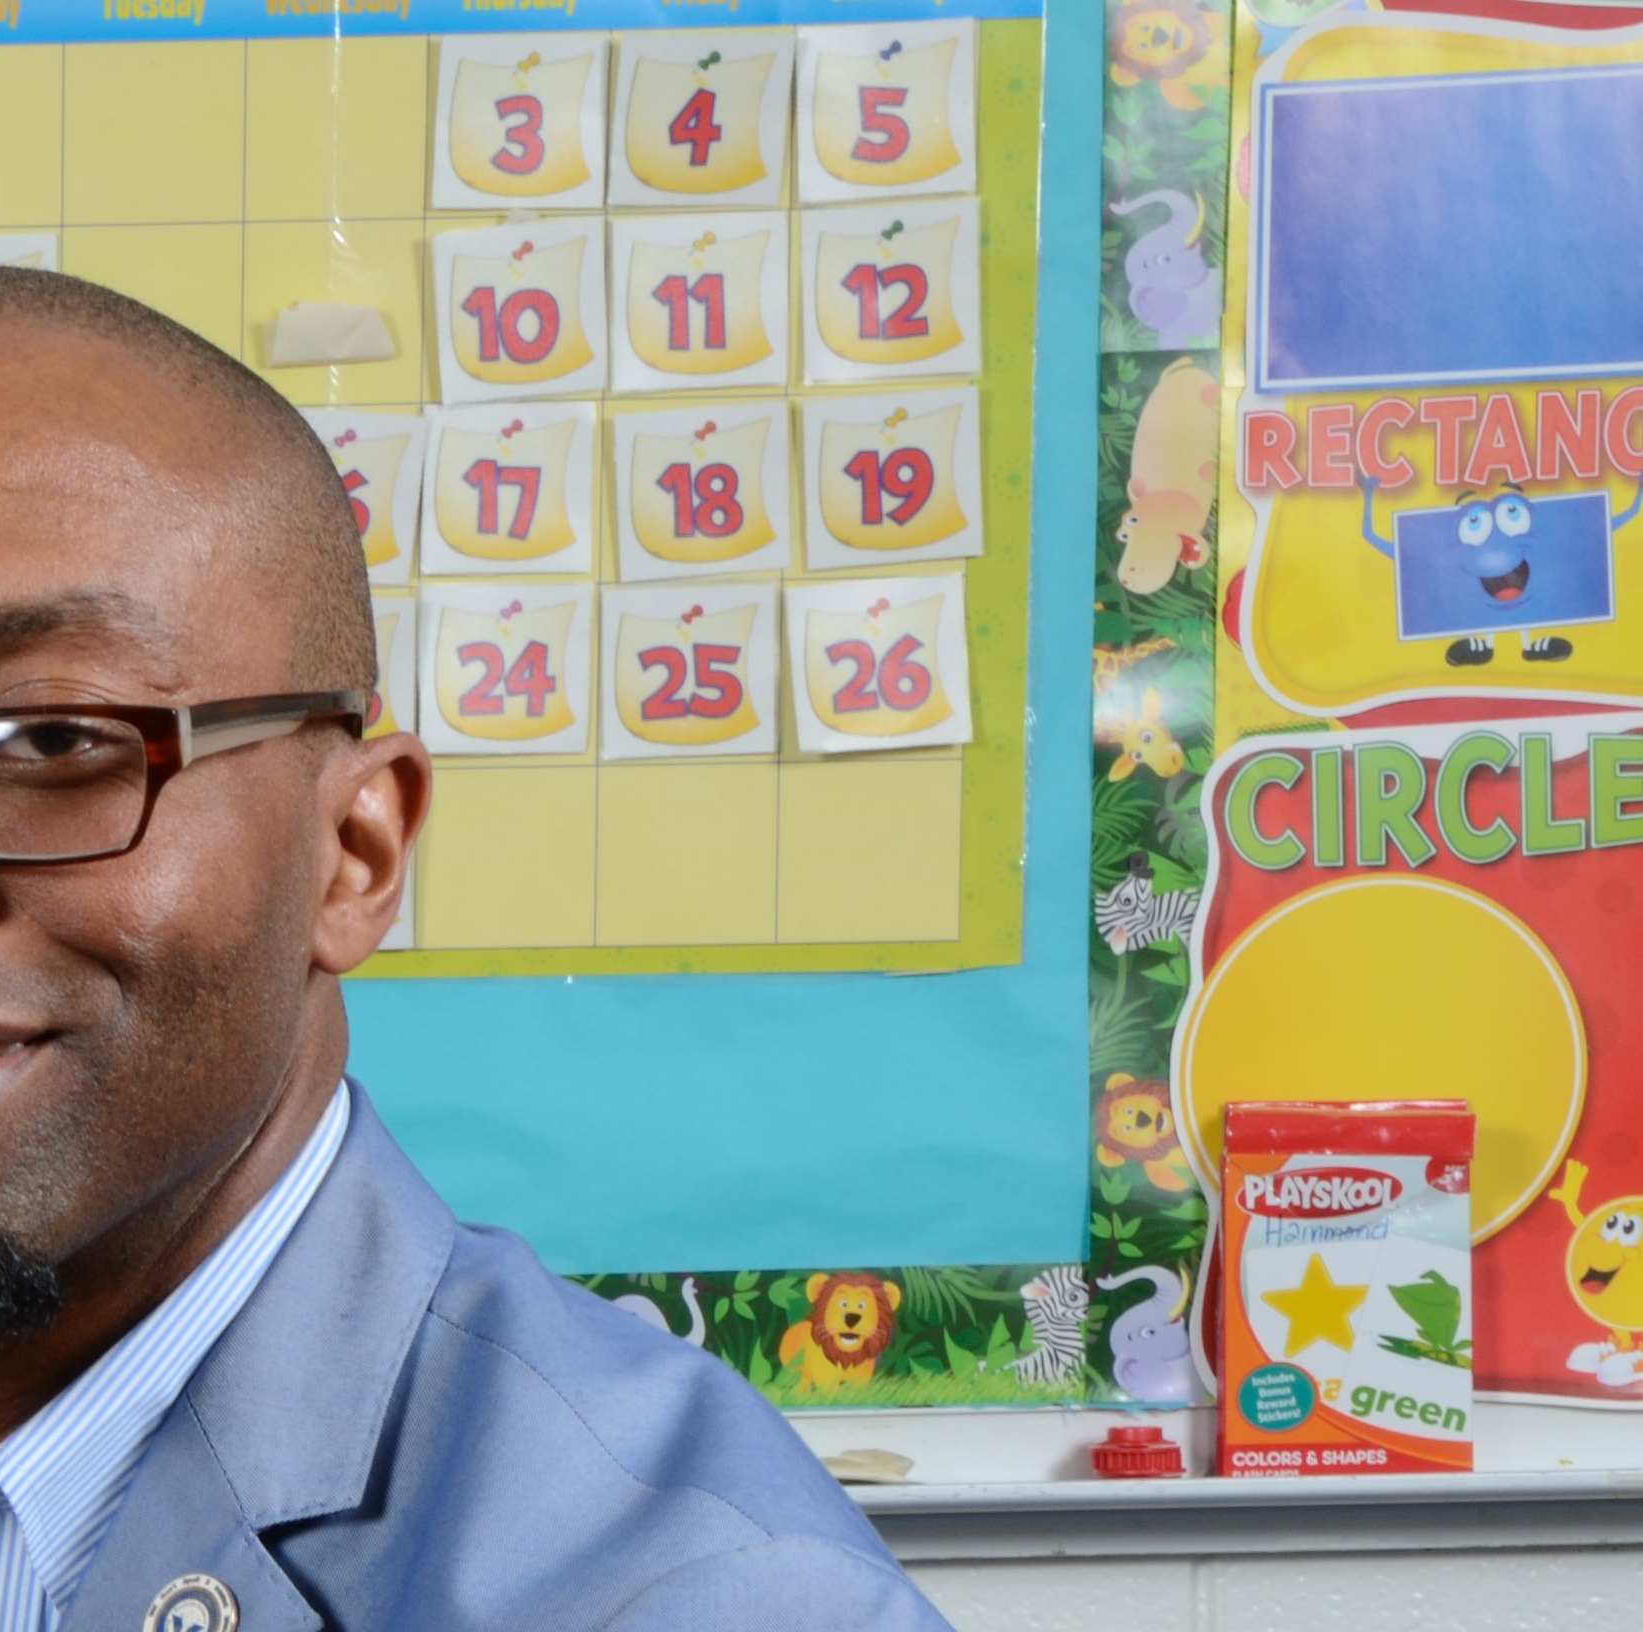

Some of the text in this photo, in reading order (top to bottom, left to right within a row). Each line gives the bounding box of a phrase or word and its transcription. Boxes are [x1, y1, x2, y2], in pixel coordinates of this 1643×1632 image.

[490, 86, 910, 174] 3 4 5
[461, 264, 929, 364] 10 11 12
[464, 458, 541, 540] 17
[656, 463, 744, 538] 18
[843, 447, 934, 526] 19
[457, 638, 556, 716] 24
[638, 643, 742, 721] 25
[825, 634, 932, 714] 26
[1224, 730, 1643, 870] CIRCLE
[1245, 1174, 1397, 1210] PLAYSKOOL
[1350, 1385, 1467, 1432] green
[1232, 1450, 1387, 1466] COLORS & SHAPES
